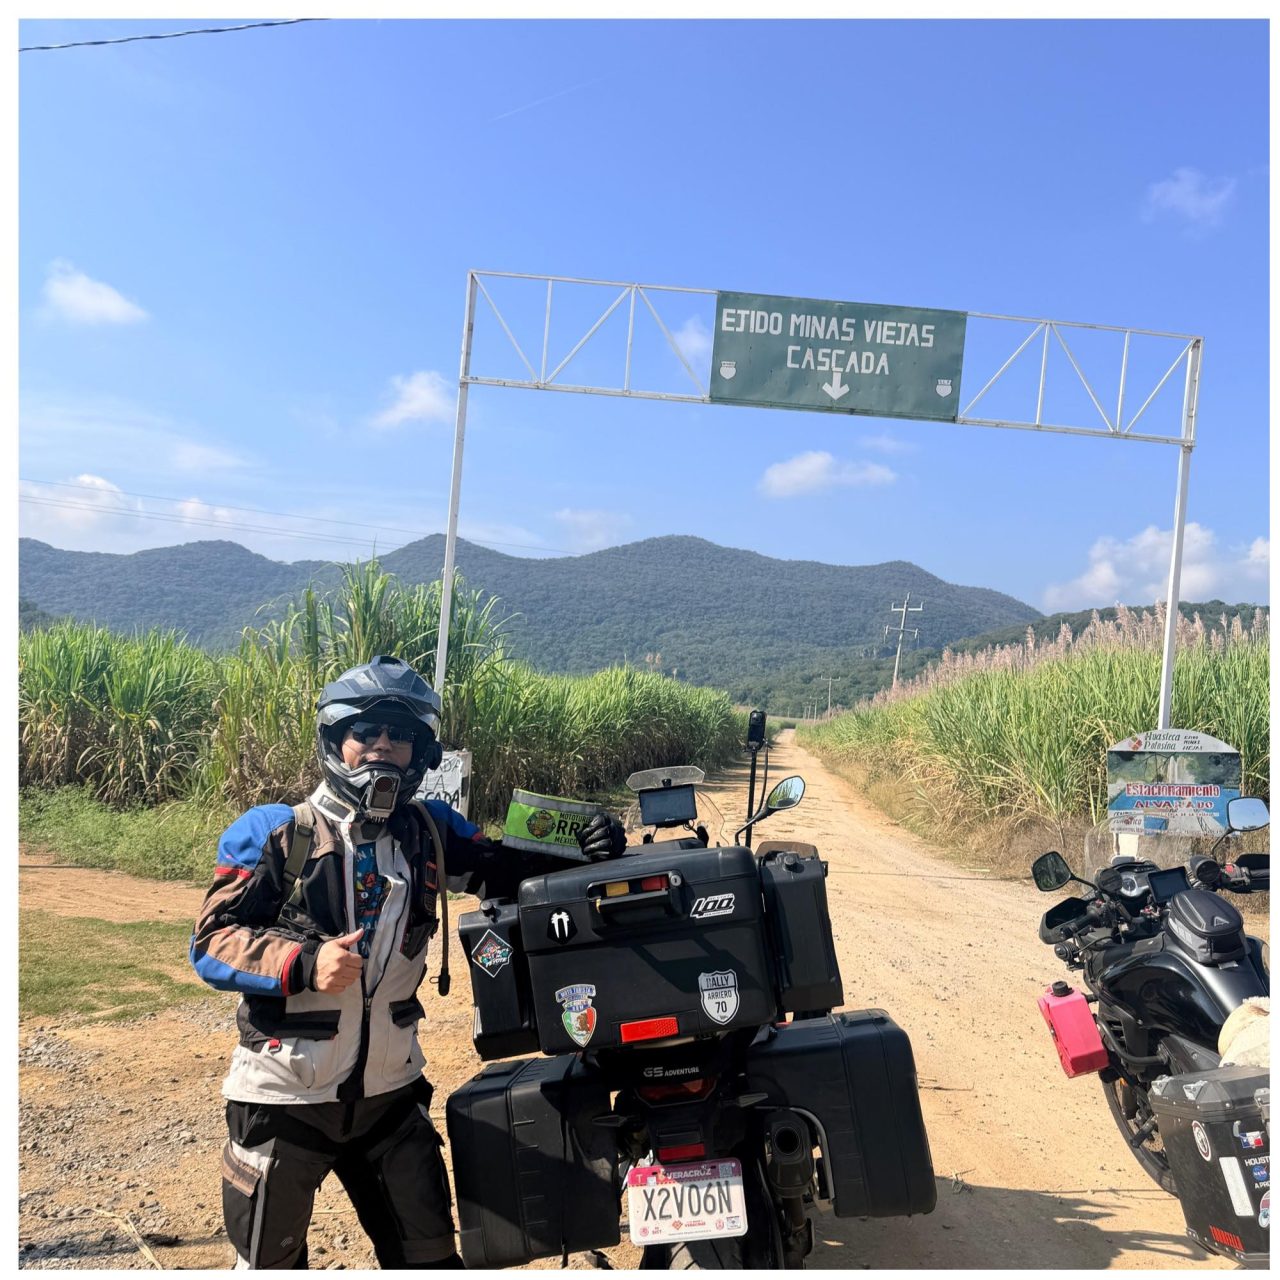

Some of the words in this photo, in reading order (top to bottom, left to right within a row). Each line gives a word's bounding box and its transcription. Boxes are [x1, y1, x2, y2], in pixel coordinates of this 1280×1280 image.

[721, 308, 783, 335] EJIDO
[789, 313, 856, 342] MINAS
[863, 319, 936, 348] VIEJAS
[786, 345, 890, 375] CASCADA
[425, 773, 445, 791] LA
[705, 975, 729, 988] RALLY
[707, 990, 733, 1000] ARRIERO
[715, 1001, 727, 1013] 70
[643, 1066, 663, 1078] GS
[664, 1066, 700, 1077] ADVENTURE
[666, 1168, 712, 1180] VERACRUZ
[642, 1180, 733, 1222] X2V06N
